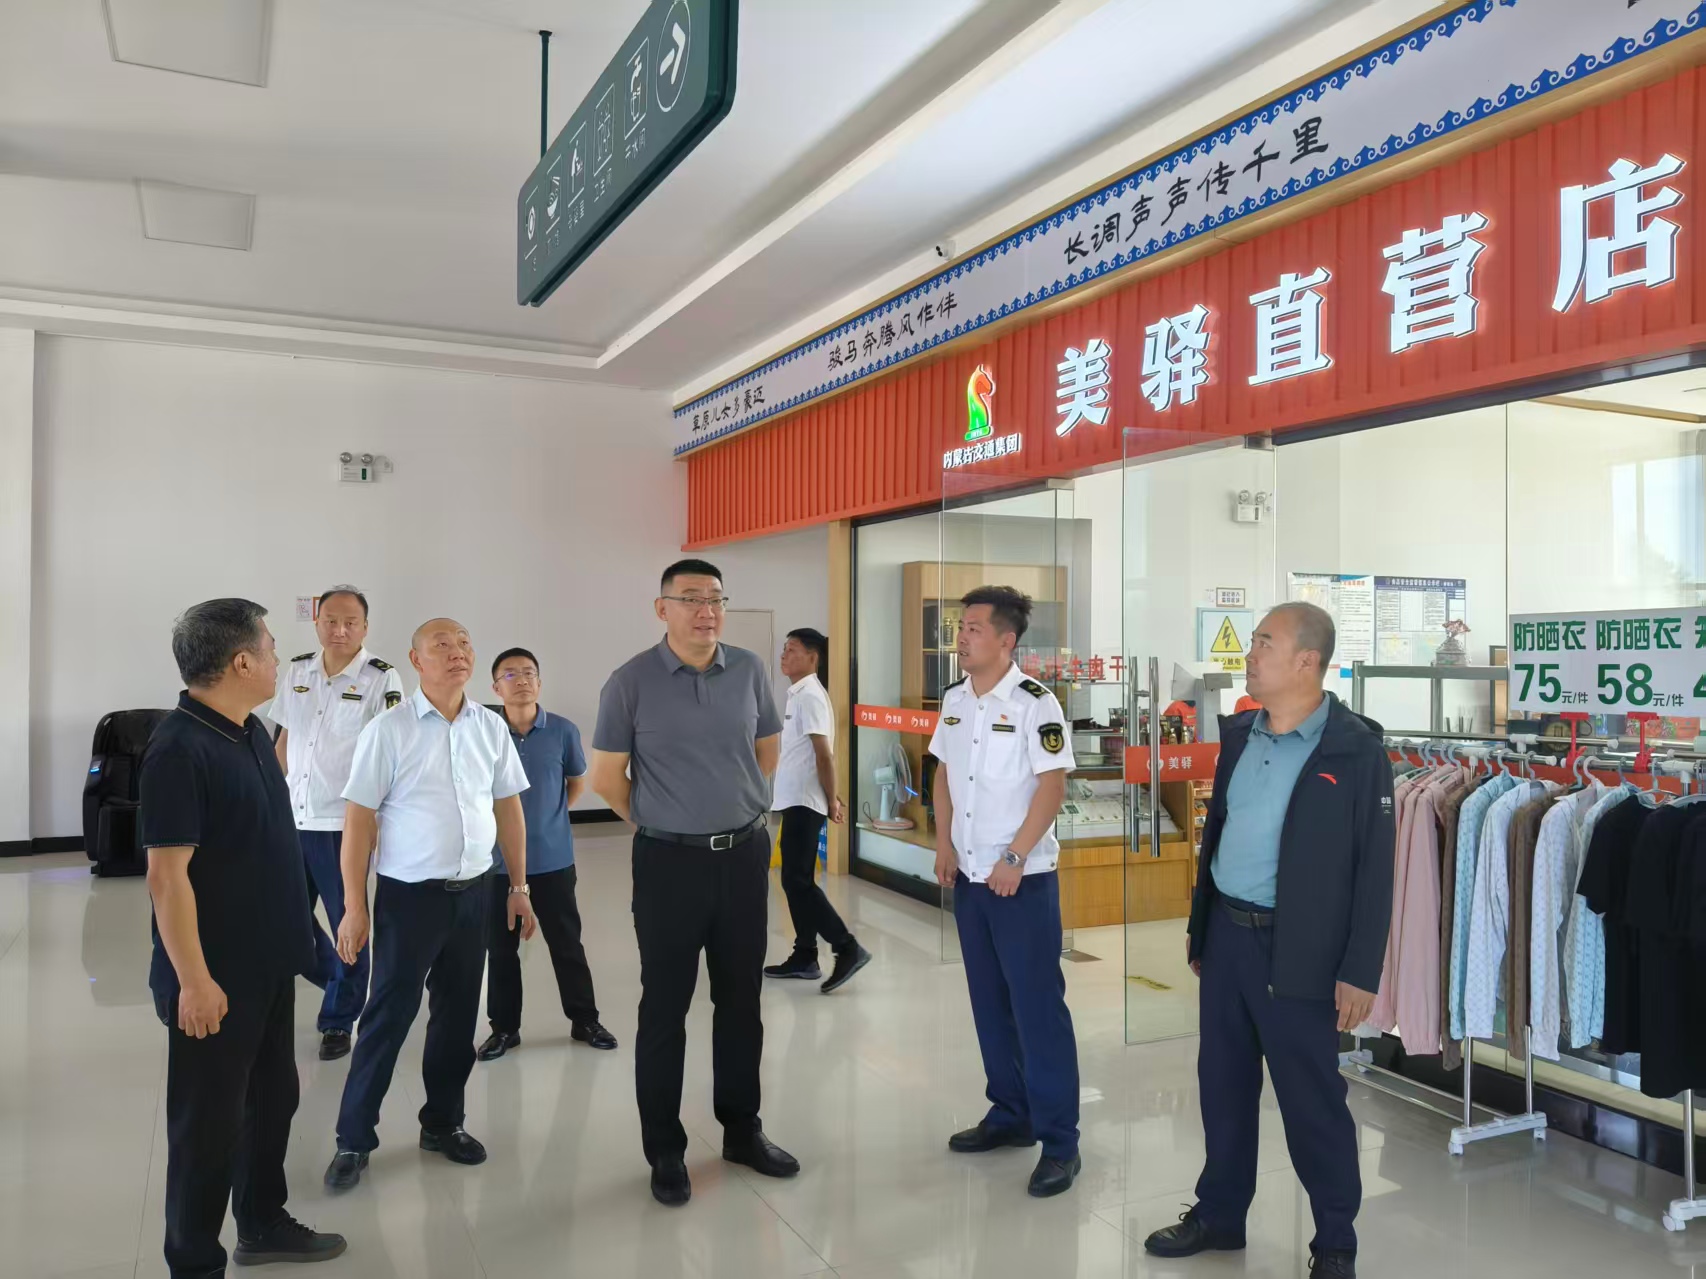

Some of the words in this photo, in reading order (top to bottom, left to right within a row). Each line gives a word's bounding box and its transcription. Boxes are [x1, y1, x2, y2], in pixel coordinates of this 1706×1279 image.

[1064, 116, 1329, 265] 长调声声传千里
[1055, 153, 1687, 437] 美驿直营店
[827, 291, 957, 371] 骏马奔腾风作伴
[692, 385, 765, 435] 草原儿女多豪迈
[943, 432, 1022, 469] 内蒙古交通集团
[1513, 621, 1586, 651] 防晒衣
[1596, 617, 1682, 651] 防晒衣
[1168, 757, 1192, 770] 美驿
